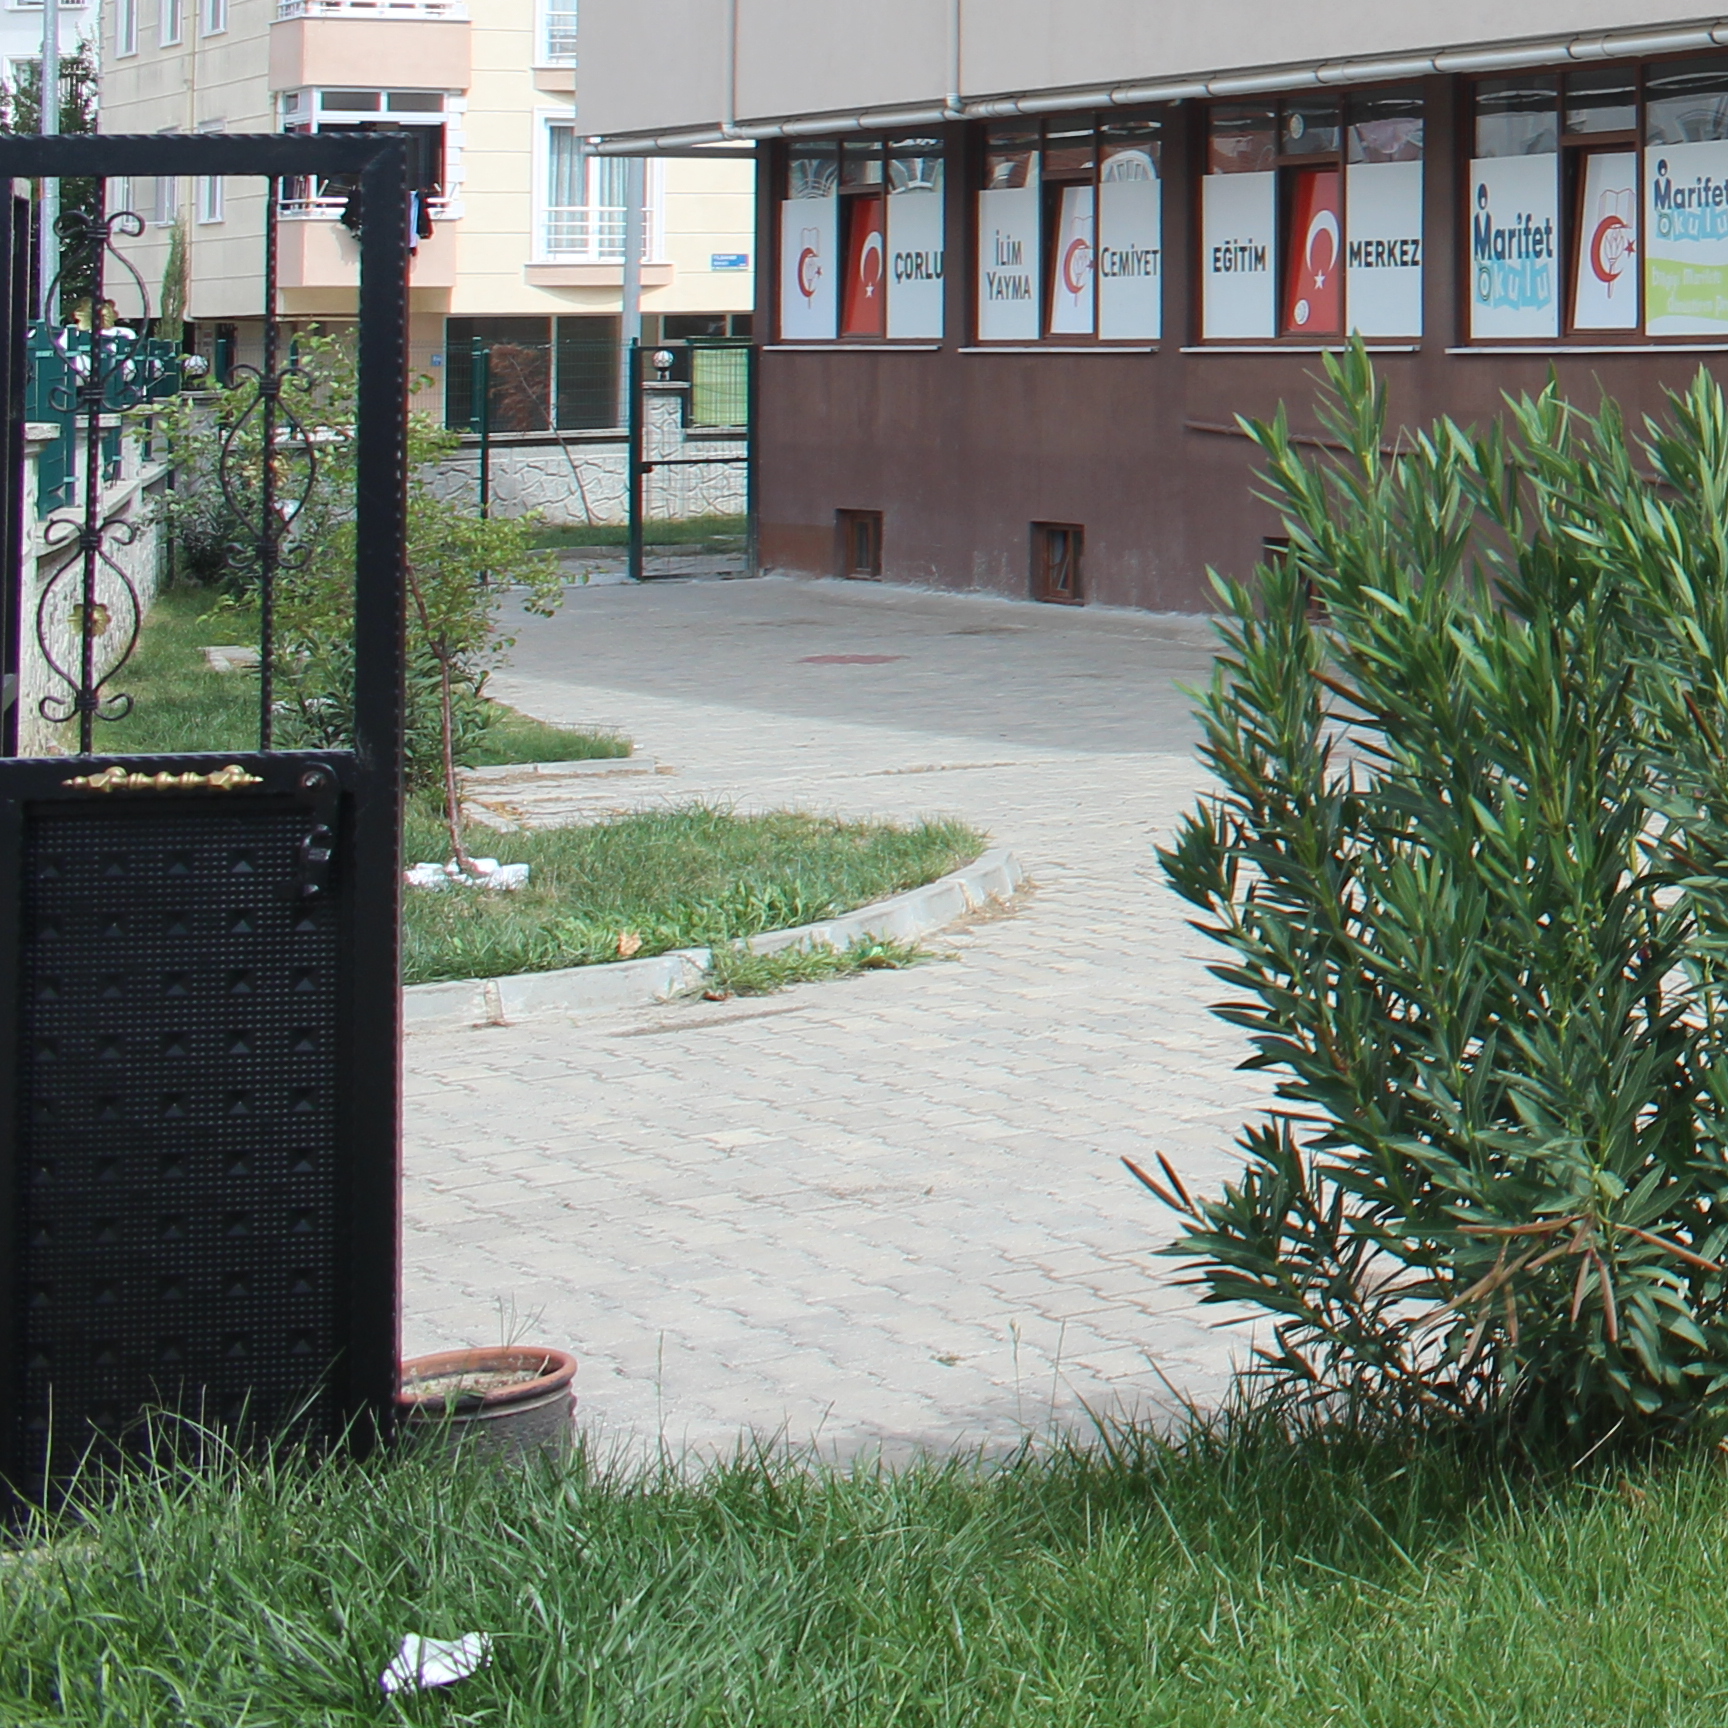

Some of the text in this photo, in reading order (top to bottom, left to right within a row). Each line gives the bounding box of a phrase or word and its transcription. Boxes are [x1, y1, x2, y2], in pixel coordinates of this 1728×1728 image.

[995, 229, 1023, 266] İLİM
[1474, 211, 1553, 261] Marifet
[895, 250, 944, 284] ÇORLU
[1213, 238, 1266, 273] EĞİTİM
[1349, 239, 1421, 269] MERKEZ
[986, 271, 1032, 301] YAYMA
